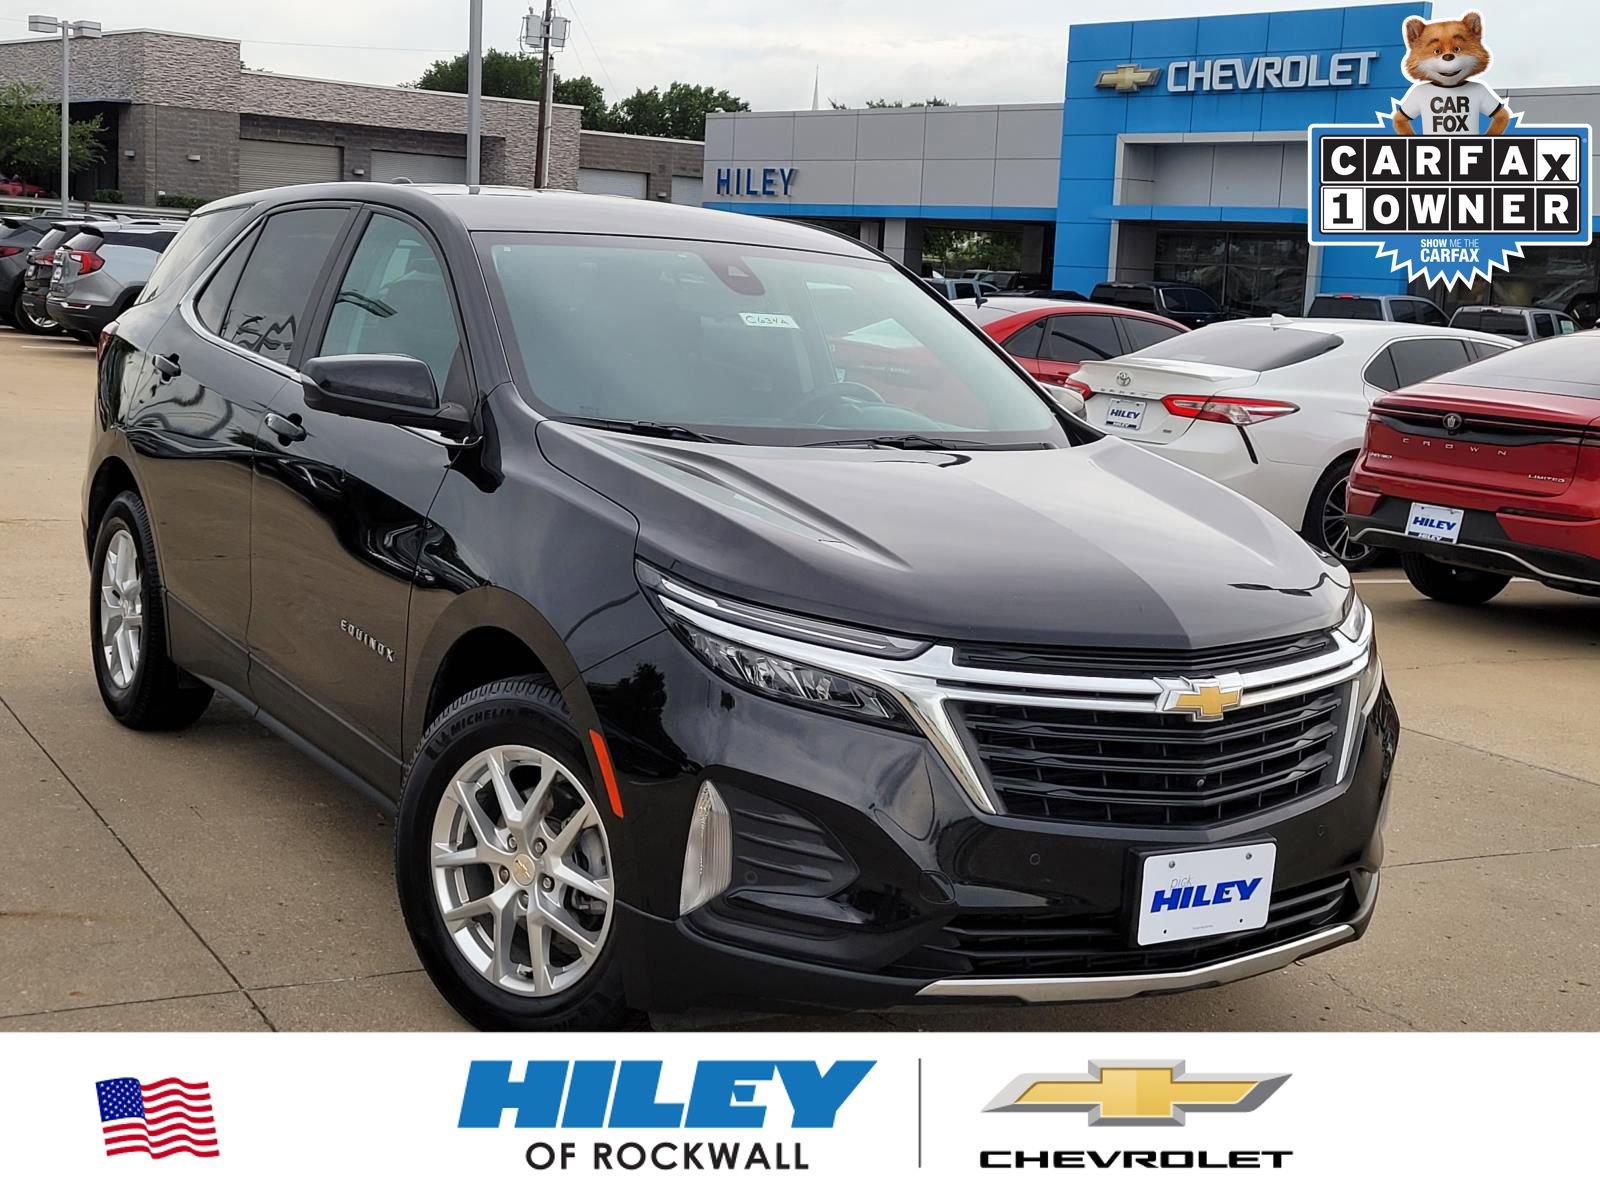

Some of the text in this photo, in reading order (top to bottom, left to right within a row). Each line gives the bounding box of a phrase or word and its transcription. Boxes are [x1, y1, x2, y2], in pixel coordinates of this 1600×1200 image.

[1167, 51, 1378, 92] CHEVROLET
[716, 168, 798, 196] HILEY
[1110, 408, 1141, 420] HILEY
[1402, 437, 1507, 457] CROWN
[1528, 473, 1566, 484] LIMITED
[1412, 515, 1458, 531] HILEY
[340, 619, 394, 663] EQUINOX
[1150, 877, 1263, 913] HILEY
